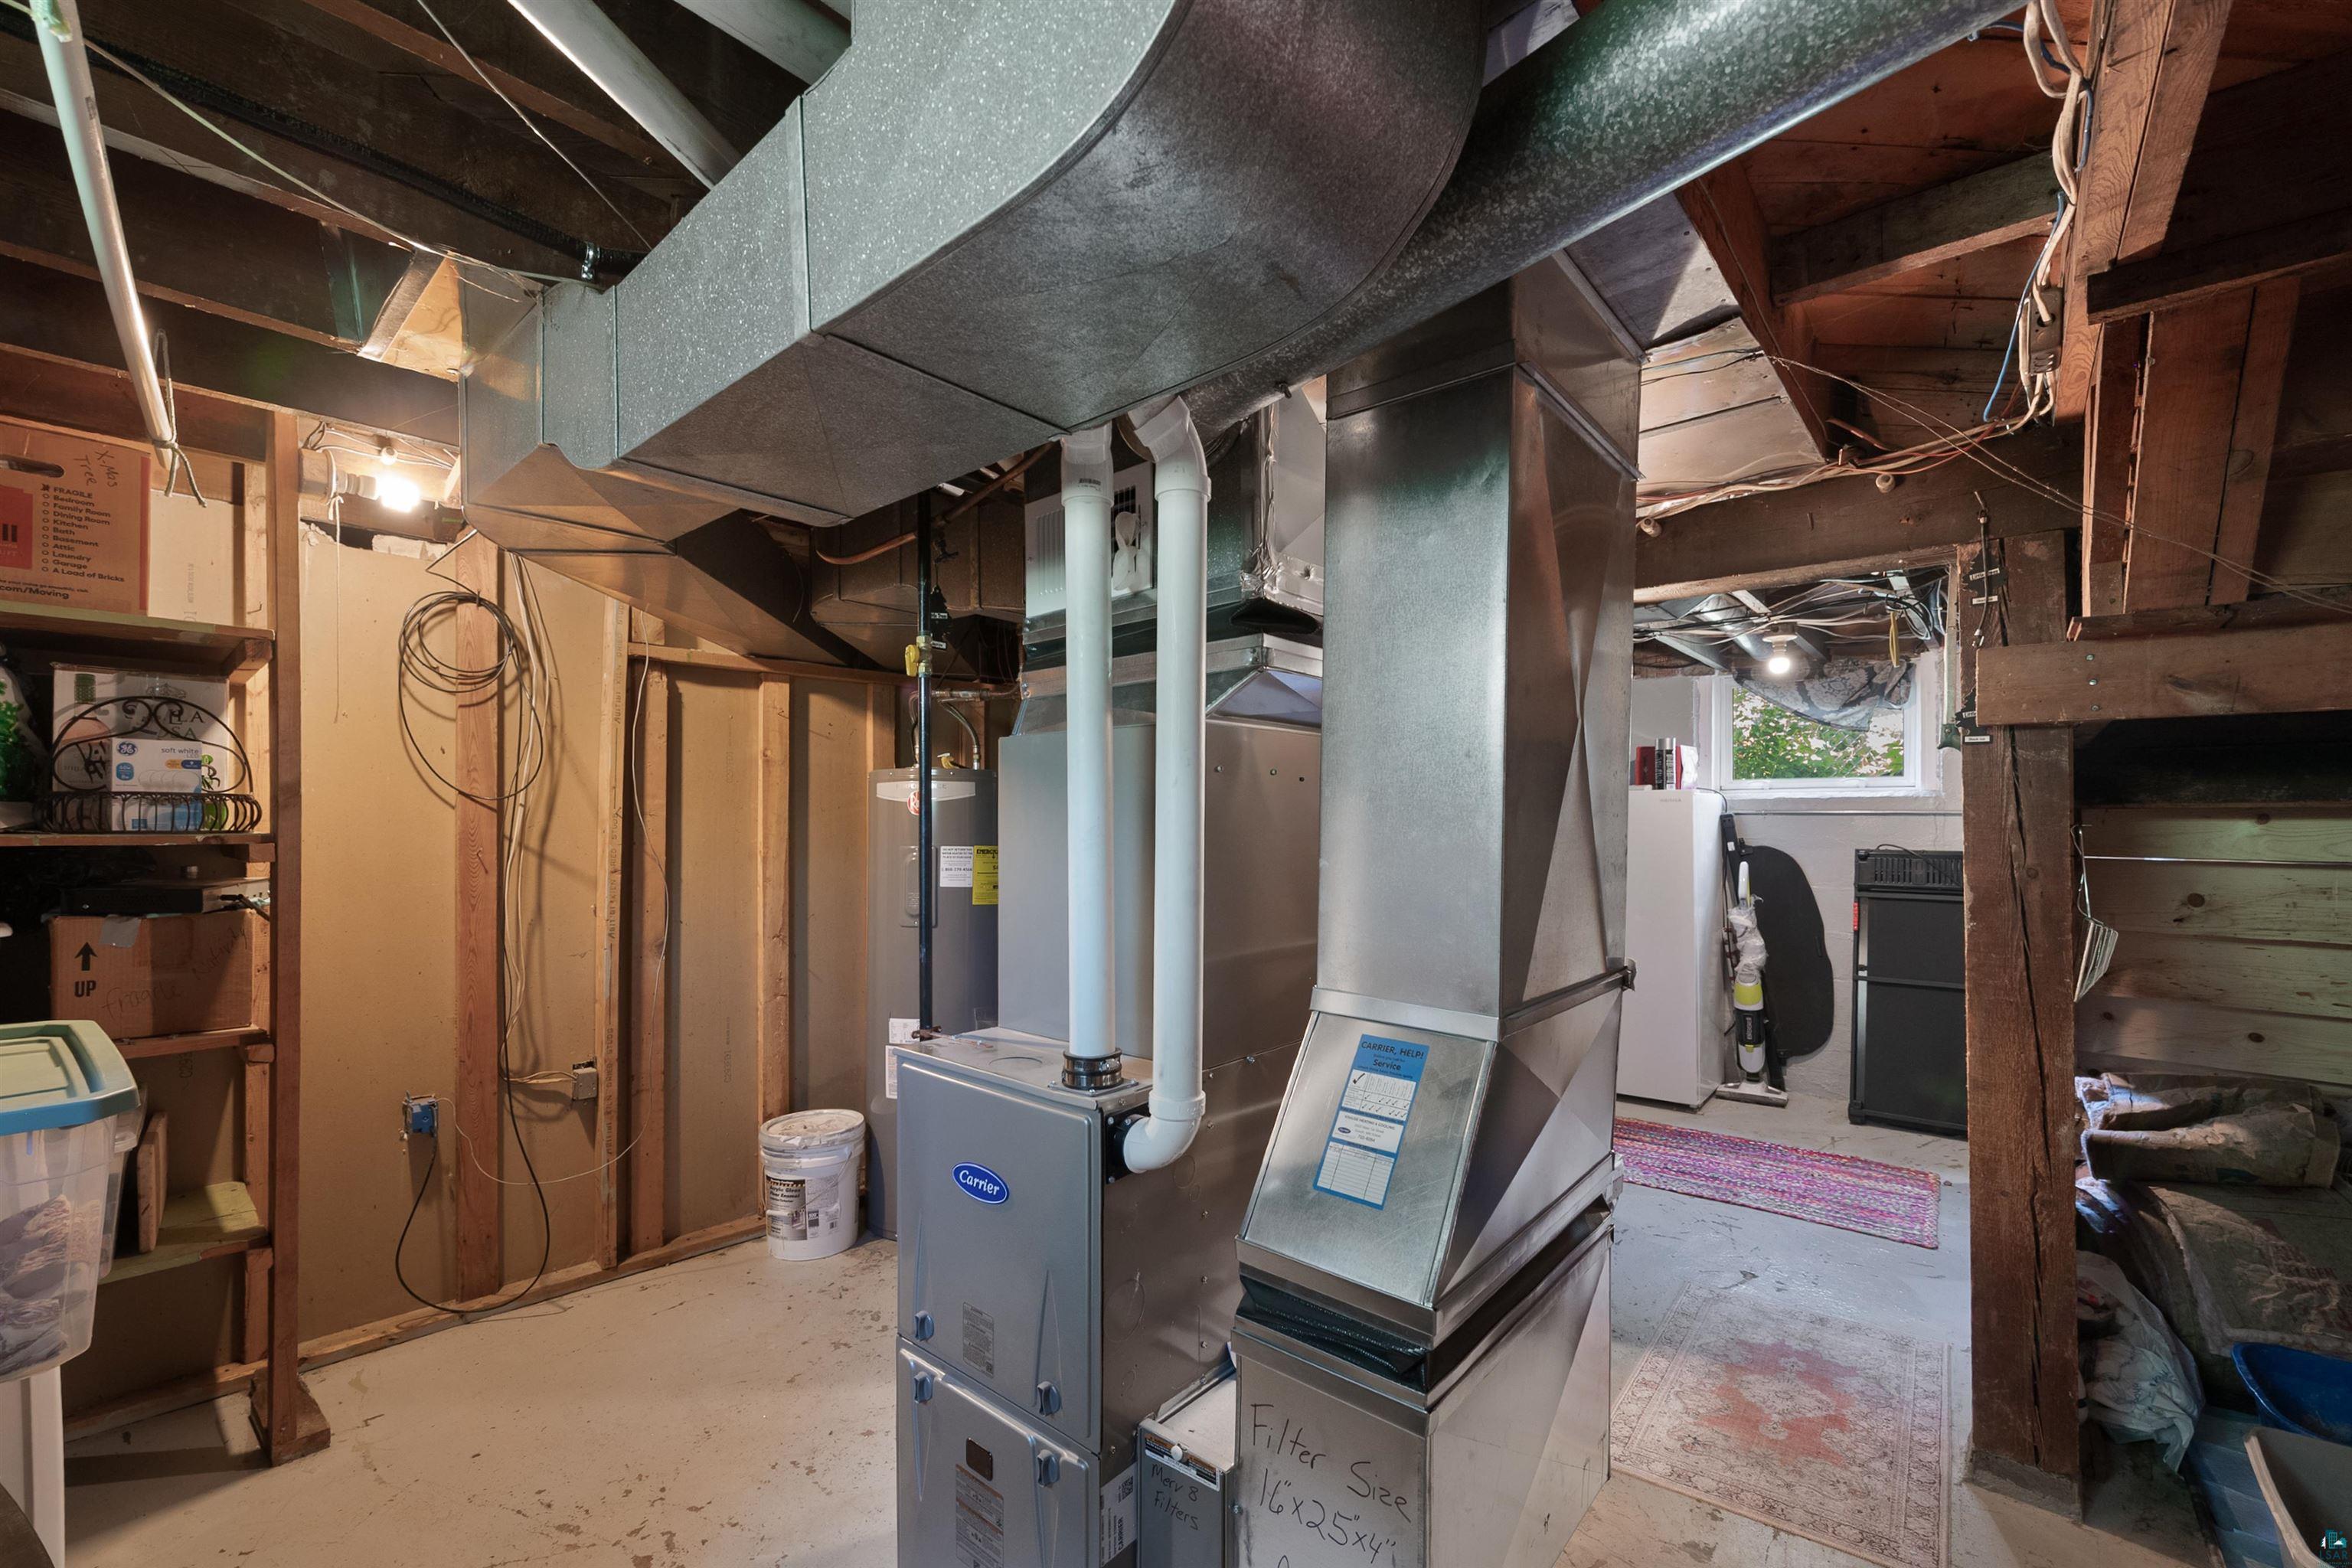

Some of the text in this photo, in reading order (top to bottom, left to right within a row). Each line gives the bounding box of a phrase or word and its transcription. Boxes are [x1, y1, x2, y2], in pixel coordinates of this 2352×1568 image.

[74, 455, 97, 486] Tree
[54, 486, 93, 498] FRAGILE
[54, 495, 95, 507] Bedroom
[53, 502, 111, 518] Family Room
[53, 511, 110, 525] Dining Room
[53, 519, 89, 530] Kitchen
[53, 527, 75, 535] Bath
[53, 535, 99, 547] Basement
[52, 551, 91, 562] Laundry
[52, 559, 88, 570] Garage
[61, 569, 85, 577] Load
[97, 573, 124, 582] Bricks
[74, 980, 96, 997] UP
[1361, 1041, 1424, 1060] CARRIER, HELP!
[1373, 1059, 1402, 1071] Service
[959, 1170, 1000, 1195] Carrier
[1250, 1403, 1327, 1469] Filter
[1347, 1461, 1411, 1523] Size
[1152, 1463, 1199, 1502] Merv 8
[1155, 1490, 1199, 1530] Filters
